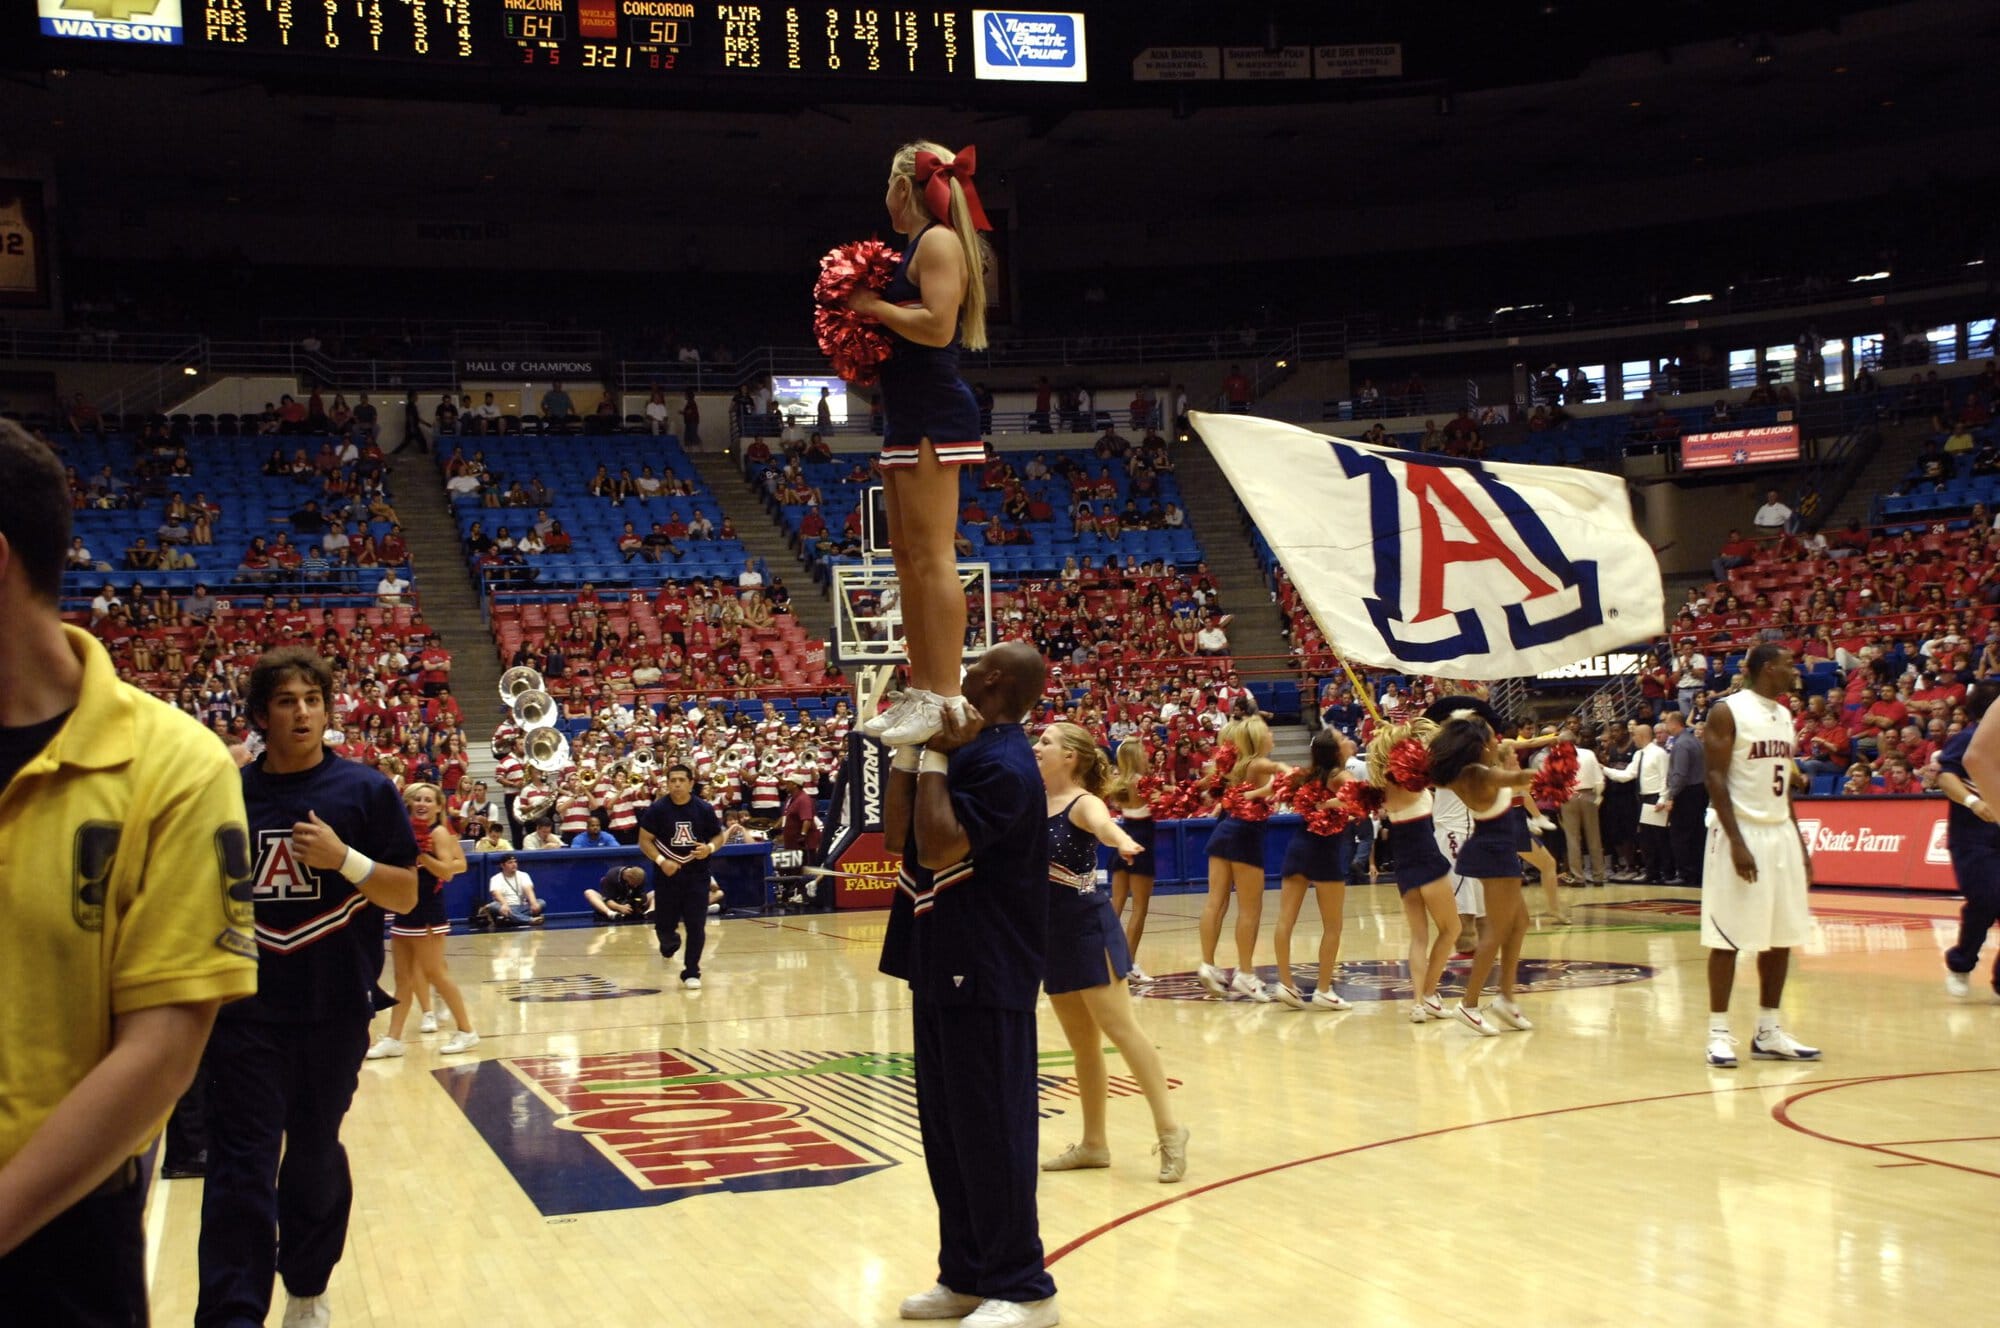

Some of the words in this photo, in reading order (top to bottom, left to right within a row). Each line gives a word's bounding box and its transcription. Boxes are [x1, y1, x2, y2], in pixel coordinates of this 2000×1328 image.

[504, 0, 563, 12] ARIZONA
[579, 9, 615, 19] WELLS
[623, 1, 694, 18] CONCORDIA
[206, 9, 246, 26] RBS
[457, 25, 471, 41] 4
[580, 18, 615, 27] FARGO
[718, 5, 760, 21] PLYR
[785, 8, 798, 22] 6
[826, 9, 838, 23] 9
[855, 9, 878, 25] 10
[894, 11, 916, 26] 12
[933, 12, 955, 27] 15
[51, 19, 172, 42] WATSON
[523, 15, 552, 38] 64
[649, 21, 678, 43] 50
[725, 21, 756, 36] PTS
[853, 24, 878, 40] 22
[895, 26, 917, 41] 13
[944, 28, 956, 43] 6
[1005, 18, 1055, 34] Tucson
[207, 26, 247, 43] FLS
[325, 33, 340, 48] 0
[415, 39, 428, 54] 0
[459, 41, 472, 57] 3
[724, 37, 760, 52] RBS
[1011, 32, 1066, 47] Electric
[582, 45, 632, 69] 3:21
[725, 53, 760, 68] FLS
[828, 55, 840, 70] 0
[1017, 46, 1067, 60] Power
[466, 361, 496, 372] HALL
[501, 361, 515, 371] OF
[520, 361, 592, 373] CHAMPIONS
[1687, 433, 1708, 443] NEW
[1711, 429, 1745, 440] ONLINE
[1747, 425, 1794, 437] AUCTIONS
[1329, 441, 1603, 662] A
[1030, 583, 1042, 593] 22
[215, 600, 230, 610] 20
[631, 593, 643, 602] 21
[862, 739, 881, 826] ARIZONA
[1772, 763, 1784, 797] 5
[671, 821, 698, 847] A
[1815, 826, 1854, 852] State
[1854, 827, 1901, 852] Farm
[250, 829, 321, 901] A
[771, 849, 803, 868] FSN
[844, 877, 899, 892] FARG
